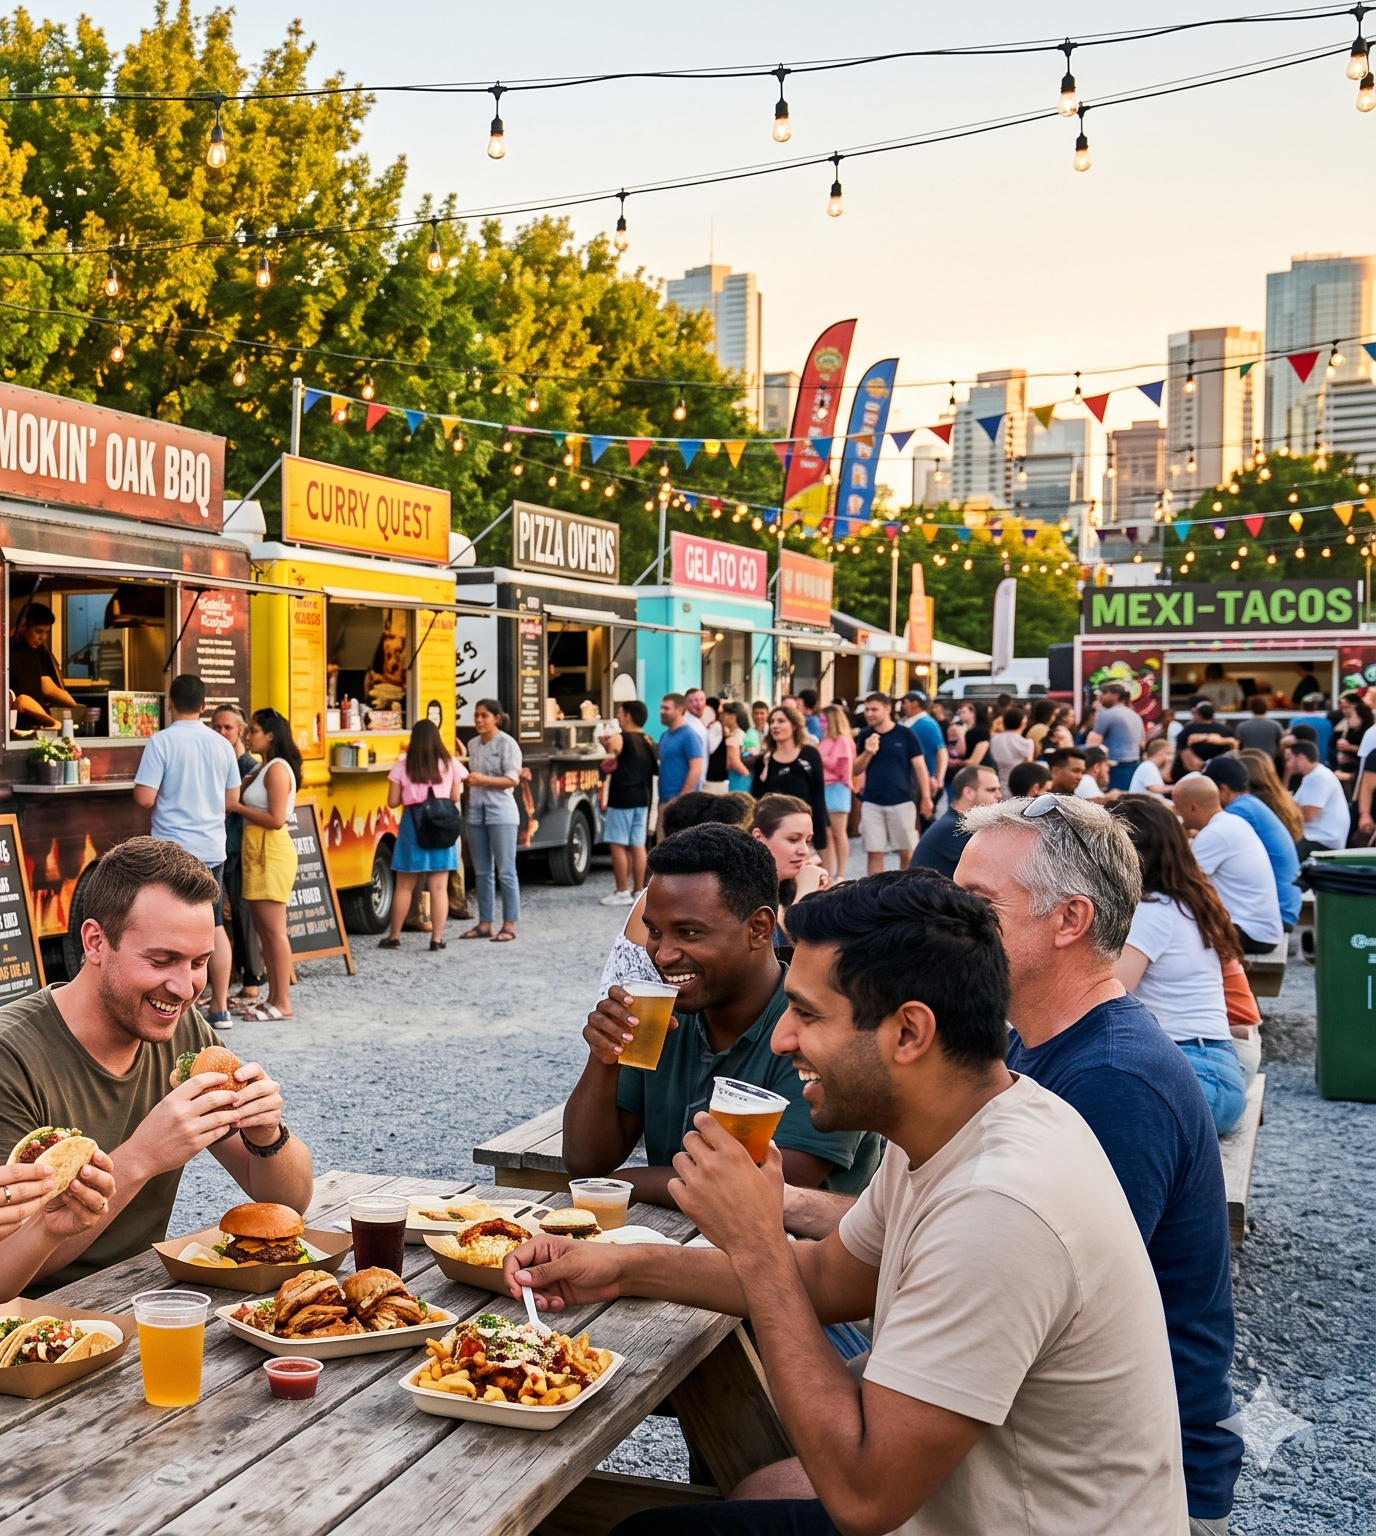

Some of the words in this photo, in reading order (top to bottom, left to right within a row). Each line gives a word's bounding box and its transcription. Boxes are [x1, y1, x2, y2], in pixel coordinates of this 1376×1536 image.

[105, 432, 157, 496] OAK
[163, 445, 211, 517] BBQ
[306, 481, 370, 528] CURRY
[376, 495, 432, 542] QUEST
[519, 511, 566, 567] PIZZA
[567, 522, 615, 575] OVENS
[685, 544, 737, 587] GELATO
[737, 553, 758, 591] GO
[1091, 586, 1354, 628] MEXI-TACOS
